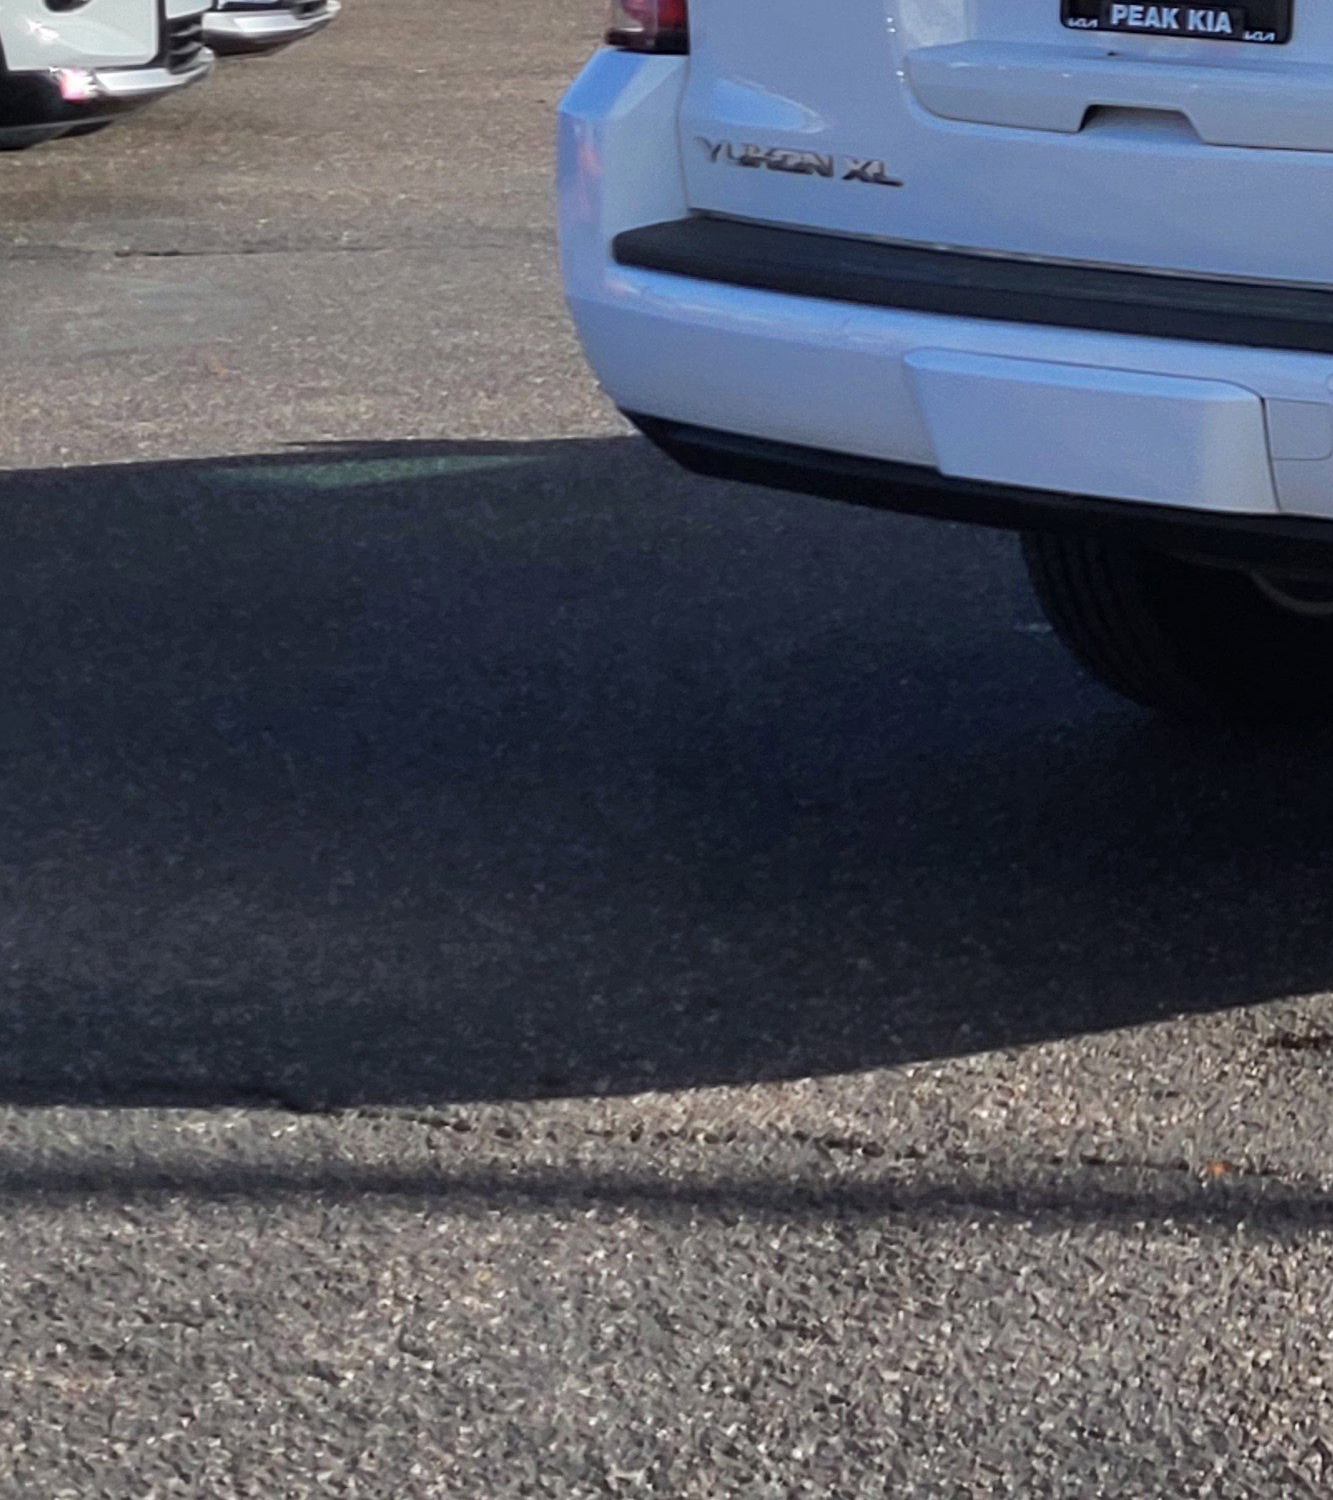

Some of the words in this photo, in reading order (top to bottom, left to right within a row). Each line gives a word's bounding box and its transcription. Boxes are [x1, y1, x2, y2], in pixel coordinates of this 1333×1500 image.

[1110, 2, 1180, 29] PEAK
[1187, 8, 1233, 34] KIA
[695, 136, 834, 178] YUKON
[841, 156, 904, 187] XL
